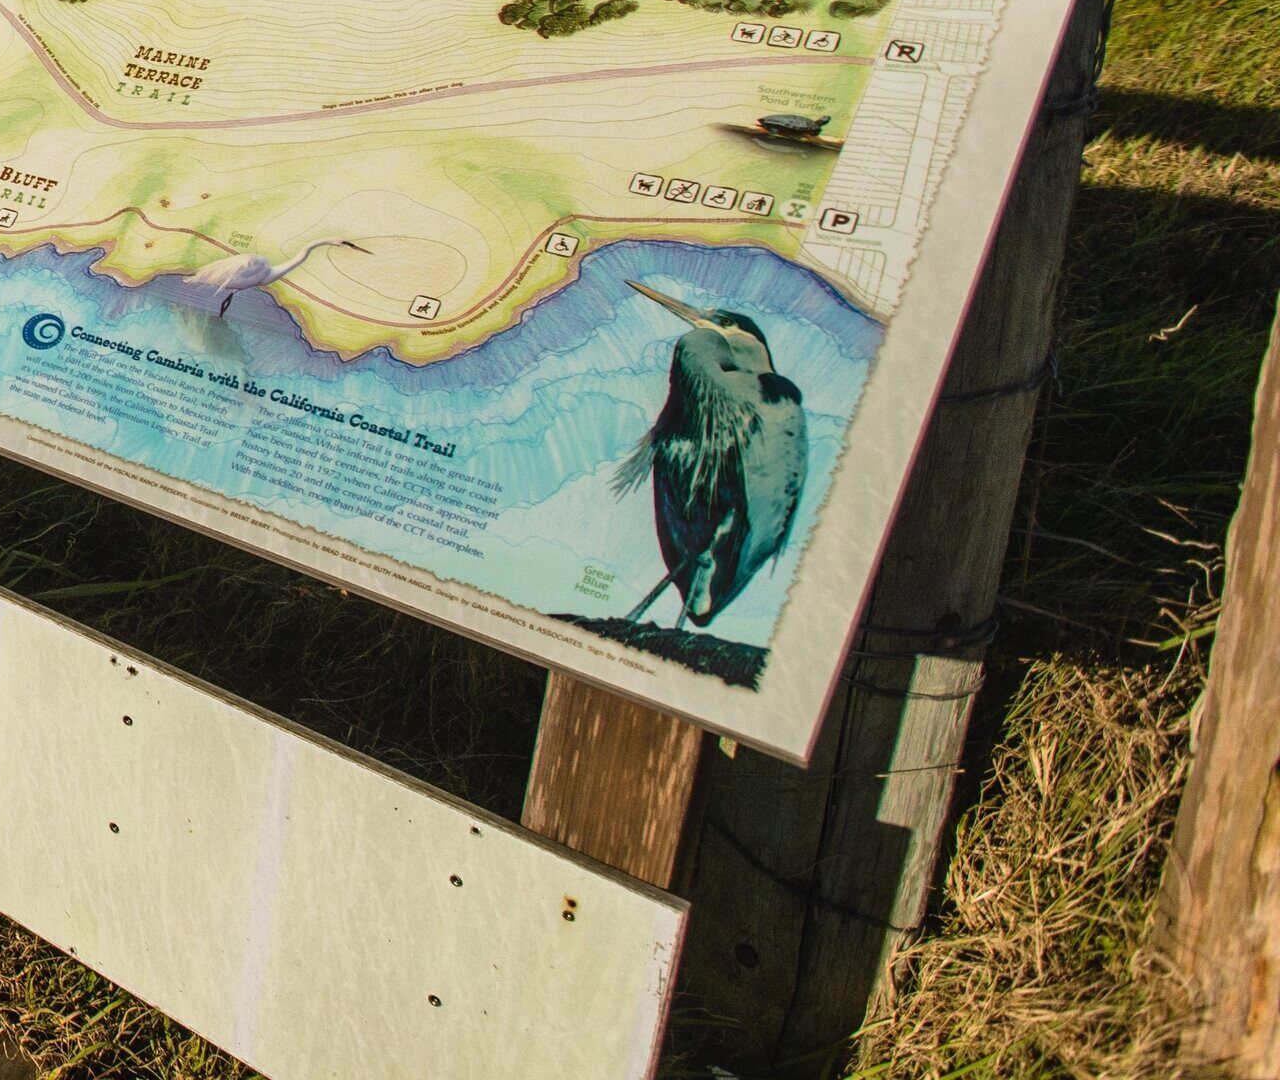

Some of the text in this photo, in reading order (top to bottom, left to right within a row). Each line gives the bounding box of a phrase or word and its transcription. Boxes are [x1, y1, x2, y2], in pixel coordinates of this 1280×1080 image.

[135, 46, 210, 70] MARINE
[124, 63, 203, 89] TERRACE
[116, 82, 190, 105] TRAIL
[758, 85, 836, 104] Southwestern
[760, 95, 826, 112] Pond Turtle
[832, 215, 850, 227] P
[25, 355, 236, 430] will extend 1,200 miles from Oregon to Mexico once
[31, 368, 72, 387] completed.
[85, 385, 105, 400] 1999,
[108, 393, 123, 404] the
[123, 398, 165, 419] California
[164, 412, 198, 430] Coastal
[198, 423, 219, 437] Trail
[70, 326, 456, 458] Connecting Cambria with the California Coastal Trail
[258, 406, 503, 492] The California Coastal Trail is one of the great trails
[240, 439, 487, 530] history began in 1972 when Californians approved
[582, 576, 609, 591] Blue
[584, 565, 615, 583] Great
[574, 583, 610, 602] Heron
